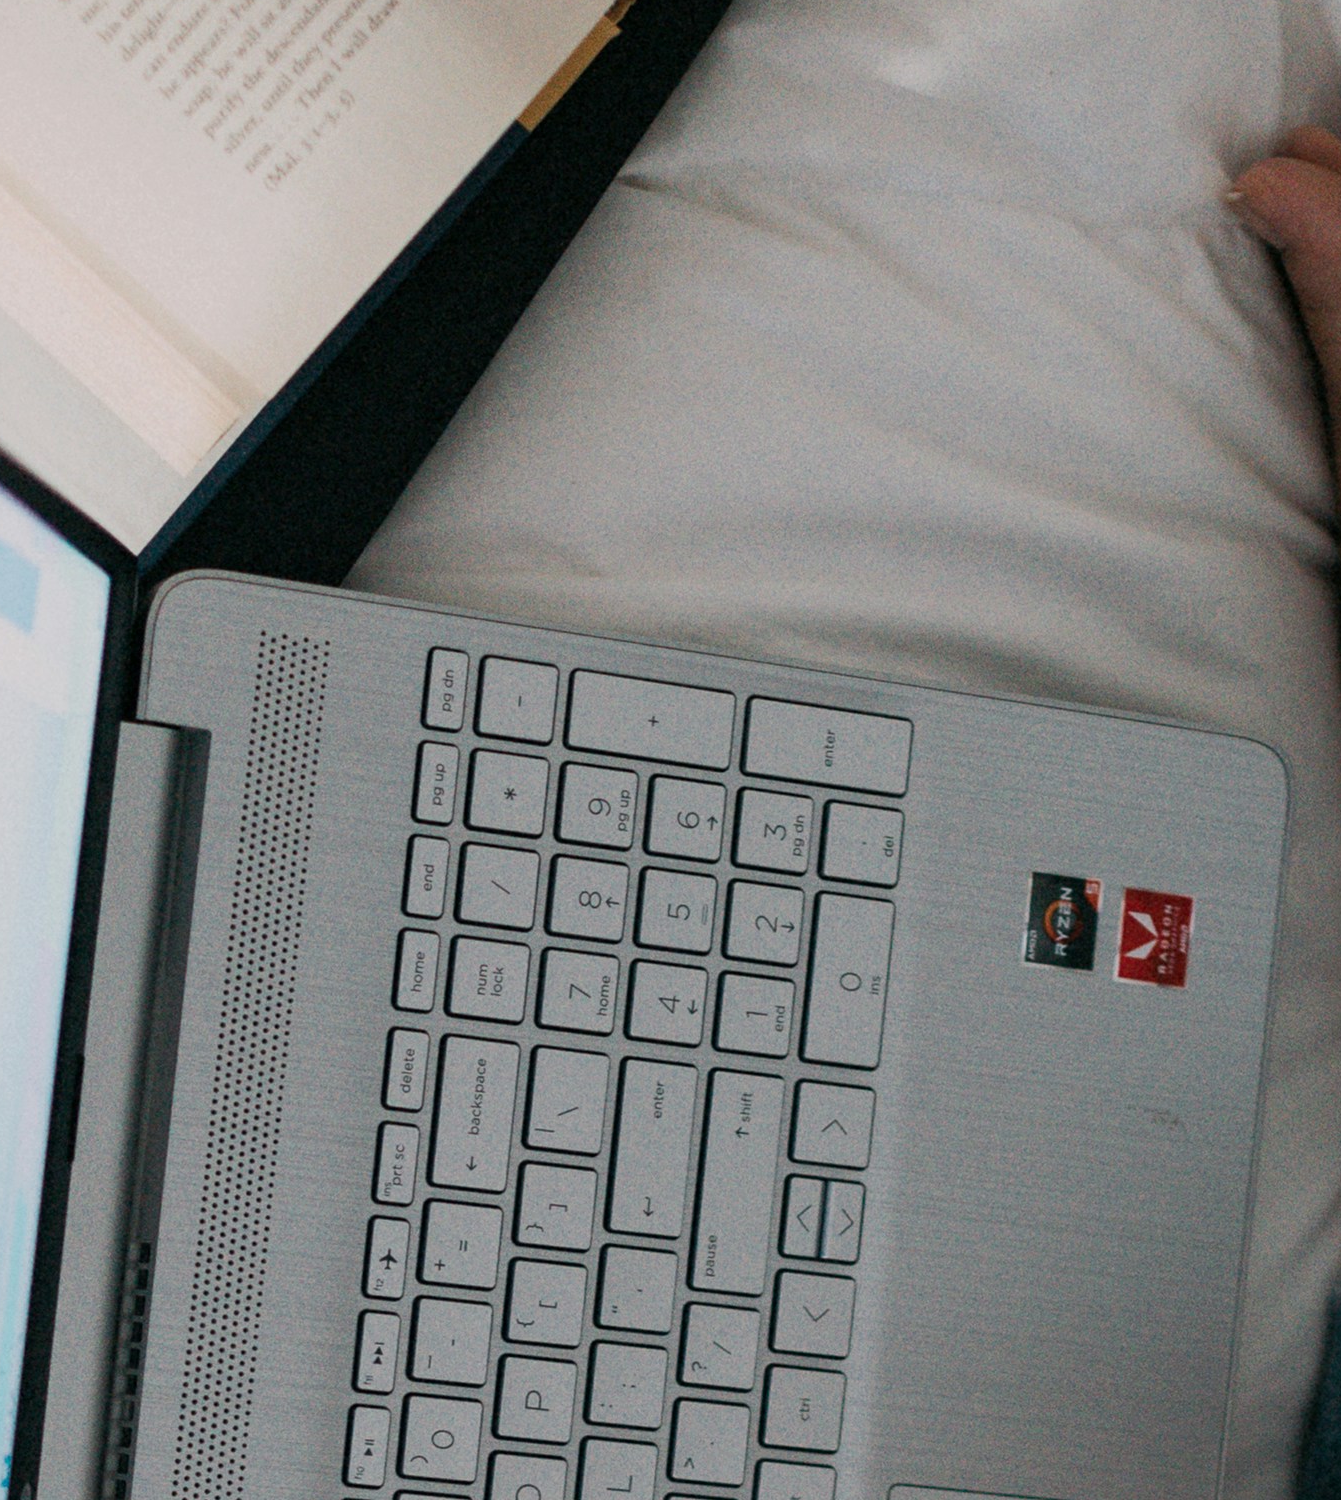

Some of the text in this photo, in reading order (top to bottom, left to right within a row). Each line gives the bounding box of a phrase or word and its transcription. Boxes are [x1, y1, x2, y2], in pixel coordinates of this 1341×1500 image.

[1055, 887, 1072, 956] RYZEN
[1158, 904, 1173, 974] RADEON
[410, 950, 426, 994] home
[399, 1047, 416, 1094] delete
[468, 1057, 488, 1137] backspace
[653, 1080, 665, 1120] enter
[523, 1388, 550, 1413] P
[606, 1474, 634, 1494] L
